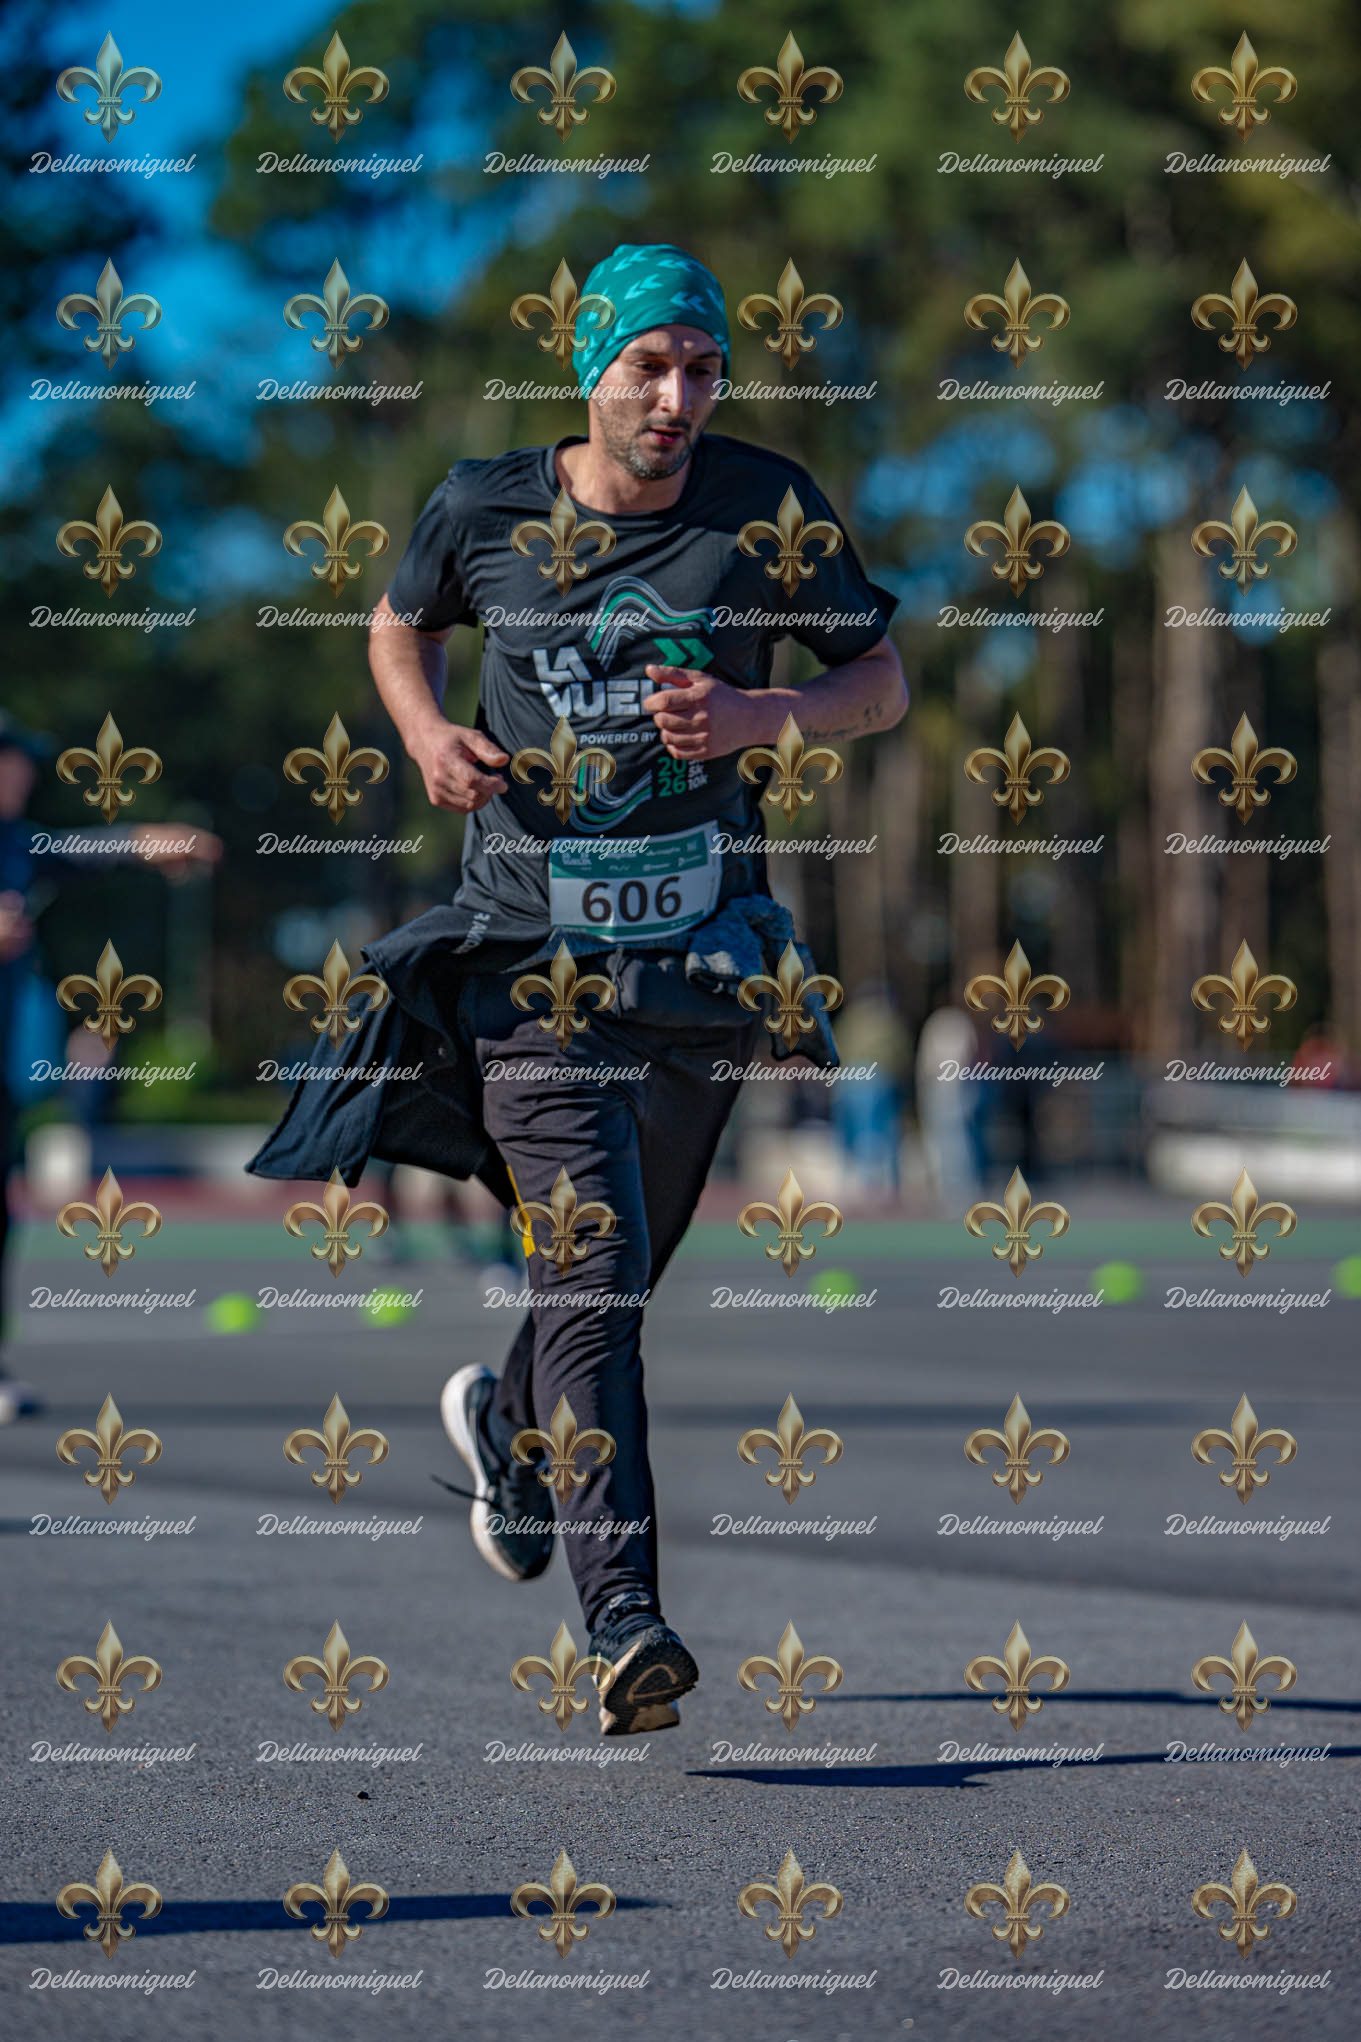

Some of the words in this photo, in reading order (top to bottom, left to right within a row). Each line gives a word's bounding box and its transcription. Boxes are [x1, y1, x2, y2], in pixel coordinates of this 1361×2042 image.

[532, 646, 592, 682] LA
[580, 732, 639, 745] POWERED
[641, 731, 657, 743] BY
[657, 756, 687, 776] 20
[657, 774, 687, 797] 26
[582, 876, 682, 923] 606
